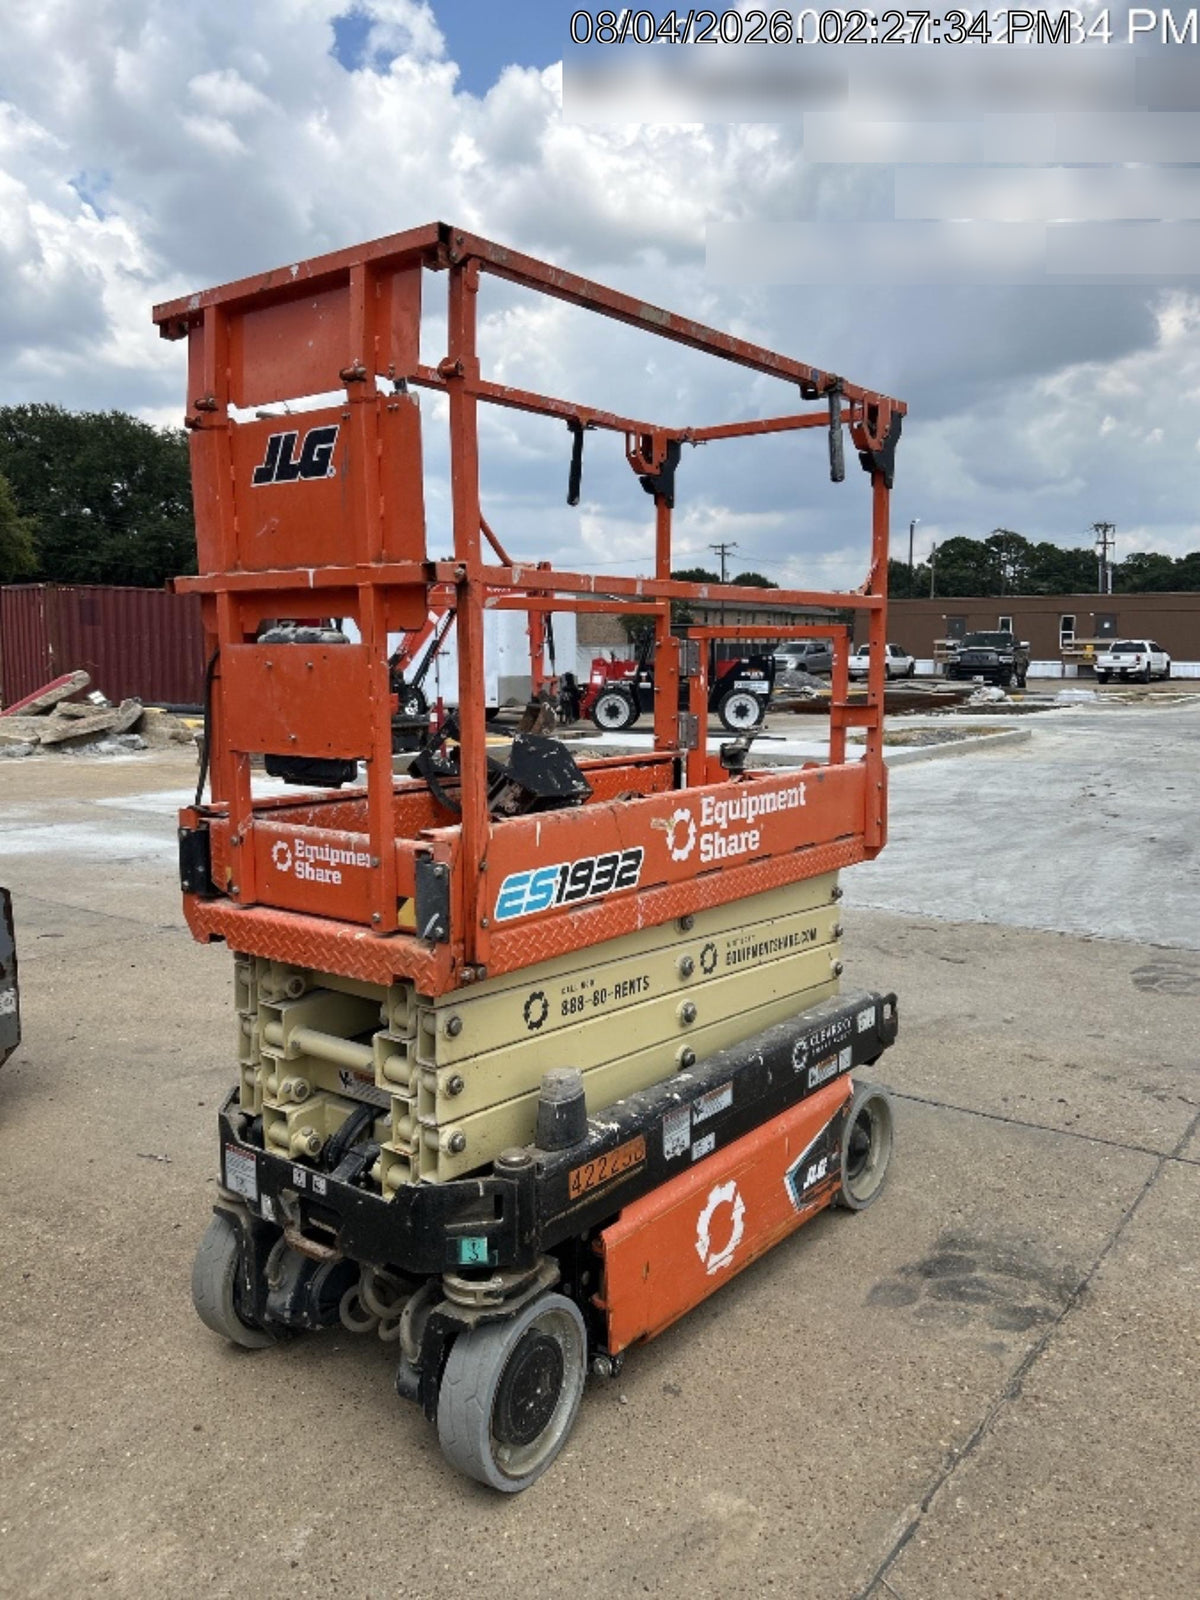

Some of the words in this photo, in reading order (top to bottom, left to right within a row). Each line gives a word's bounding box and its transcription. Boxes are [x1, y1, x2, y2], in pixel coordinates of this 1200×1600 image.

[250, 424, 340, 487] JLG
[700, 782, 807, 829] Equipment
[294, 839, 371, 868] Equipme
[700, 829, 760, 863] Share
[294, 860, 342, 884] Share
[494, 846, 645, 922] ES1932
